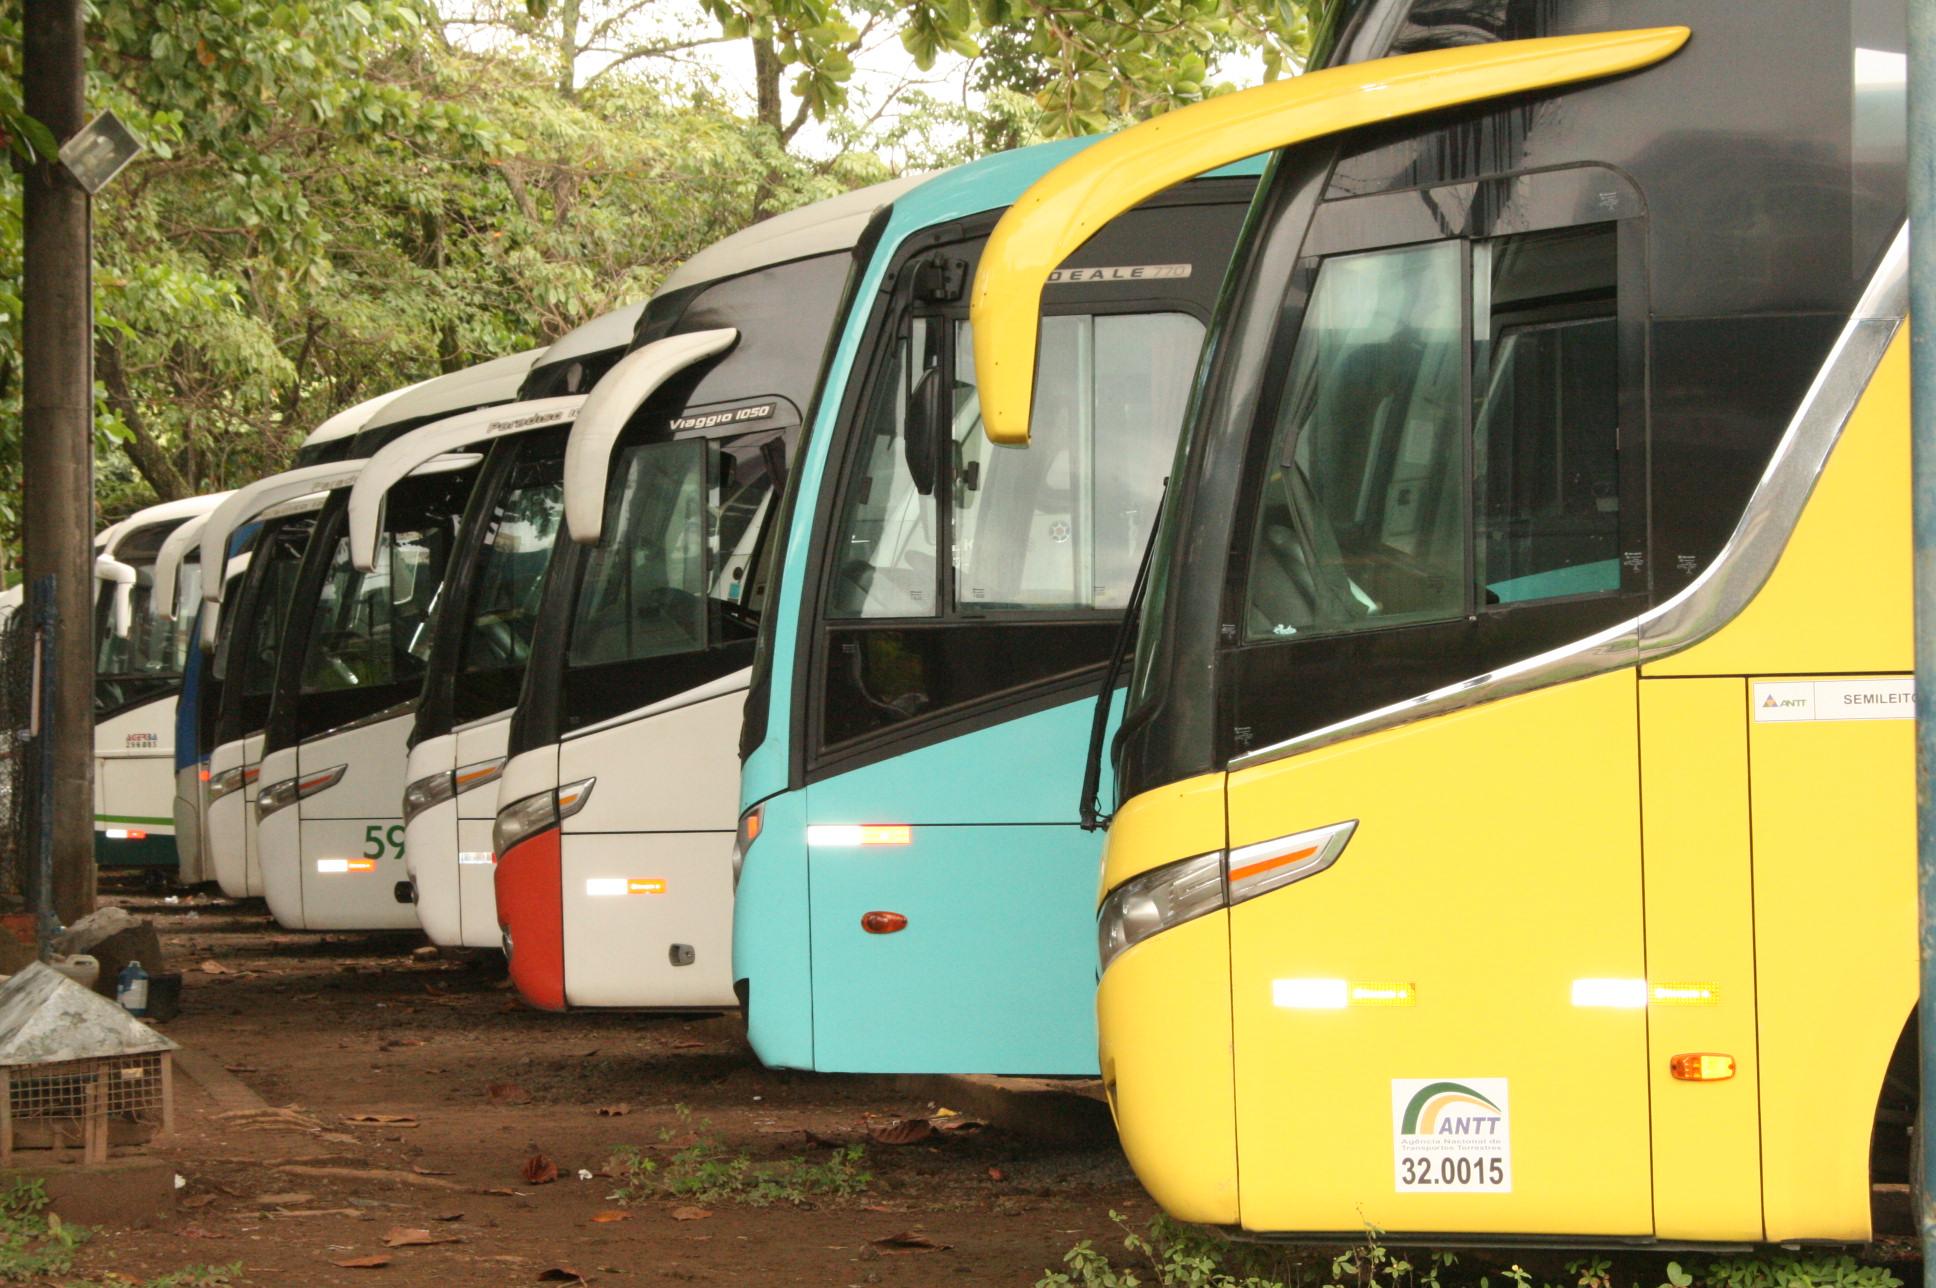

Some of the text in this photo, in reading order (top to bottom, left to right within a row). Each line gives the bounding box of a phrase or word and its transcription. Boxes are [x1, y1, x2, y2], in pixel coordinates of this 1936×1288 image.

[1048, 267, 1144, 281] DEALE
[669, 405, 769, 430] Viaggio 1050
[1779, 699, 1807, 708] ANTT
[363, 825, 405, 859] 59
[1438, 1117, 1501, 1135] ANTT
[1401, 1157, 1503, 1185] 32.0015
